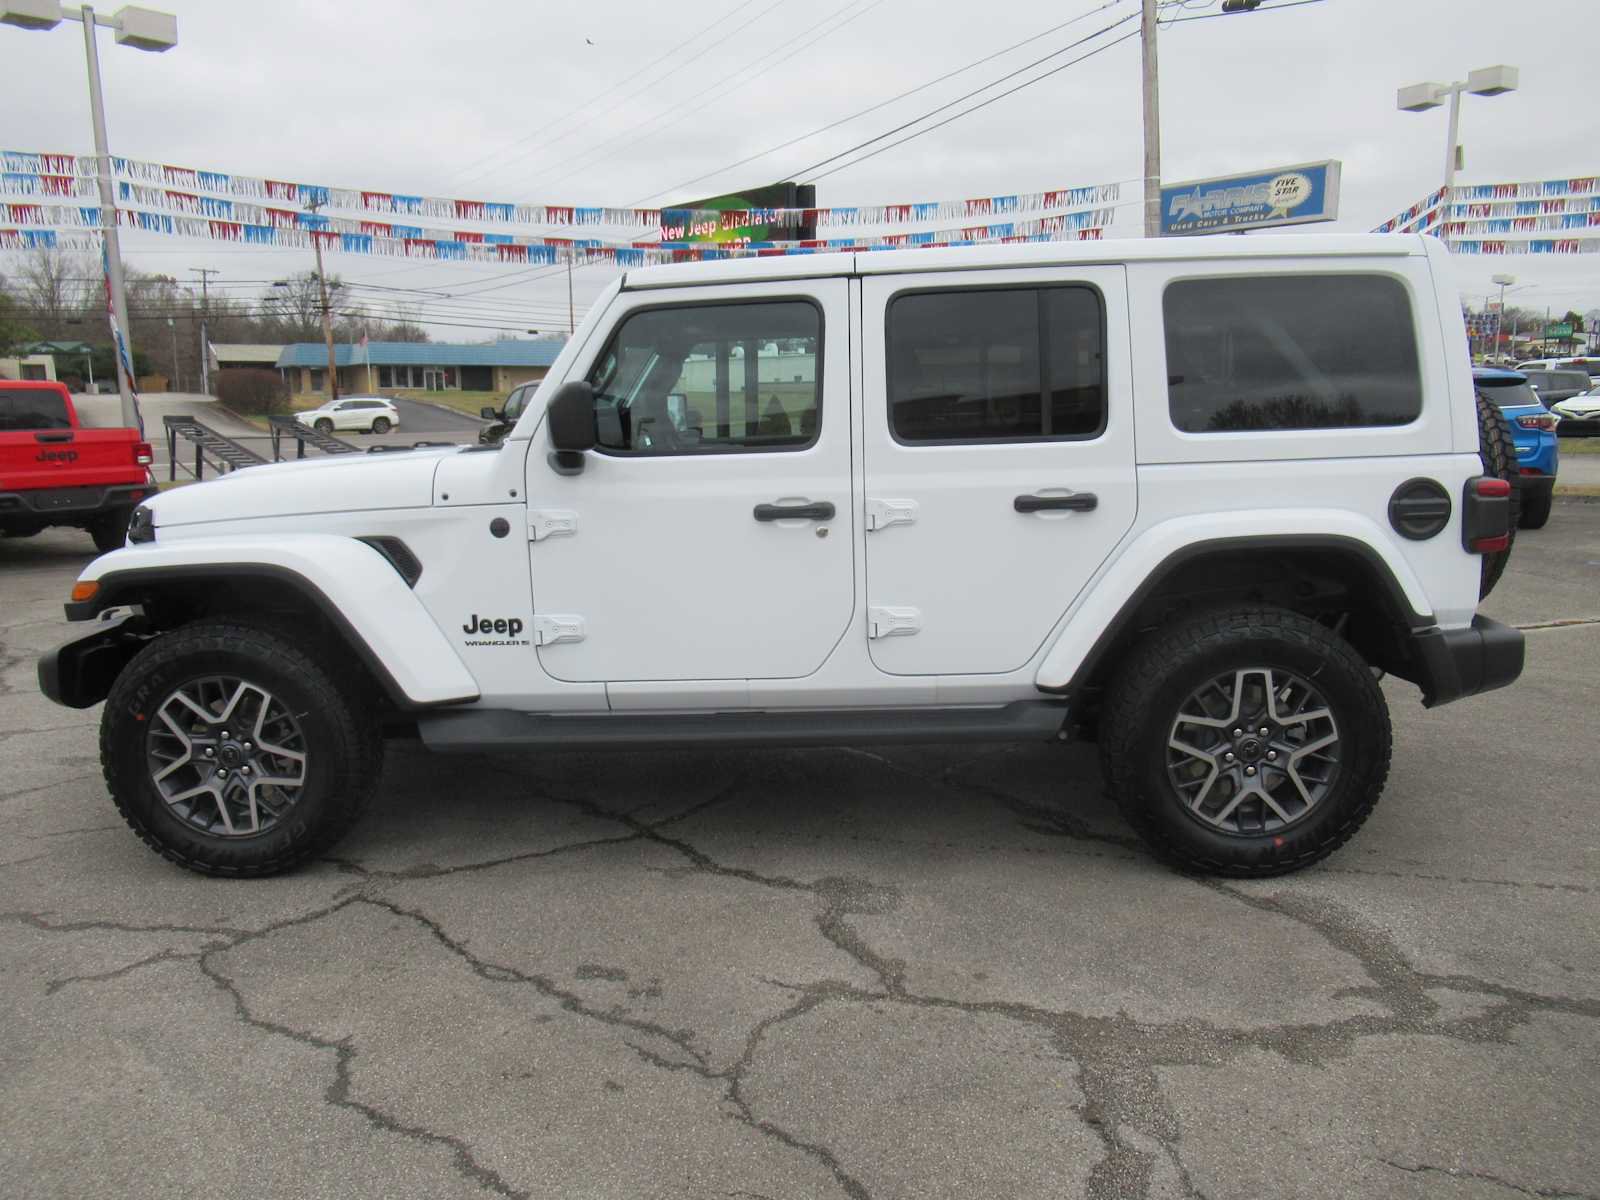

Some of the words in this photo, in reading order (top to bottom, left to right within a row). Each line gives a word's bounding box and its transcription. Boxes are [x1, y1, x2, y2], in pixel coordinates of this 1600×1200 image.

[1275, 177, 1298, 187] FIVE
[1275, 186, 1299, 196] STAR
[1230, 204, 1264, 215] COMPANY
[1170, 222, 1193, 231] Used
[1235, 213, 1265, 223] Trucks
[660, 225, 685, 241] New
[688, 220, 716, 237] Jeep
[35, 449, 79, 462] Jeep
[463, 614, 523, 637] Jeep
